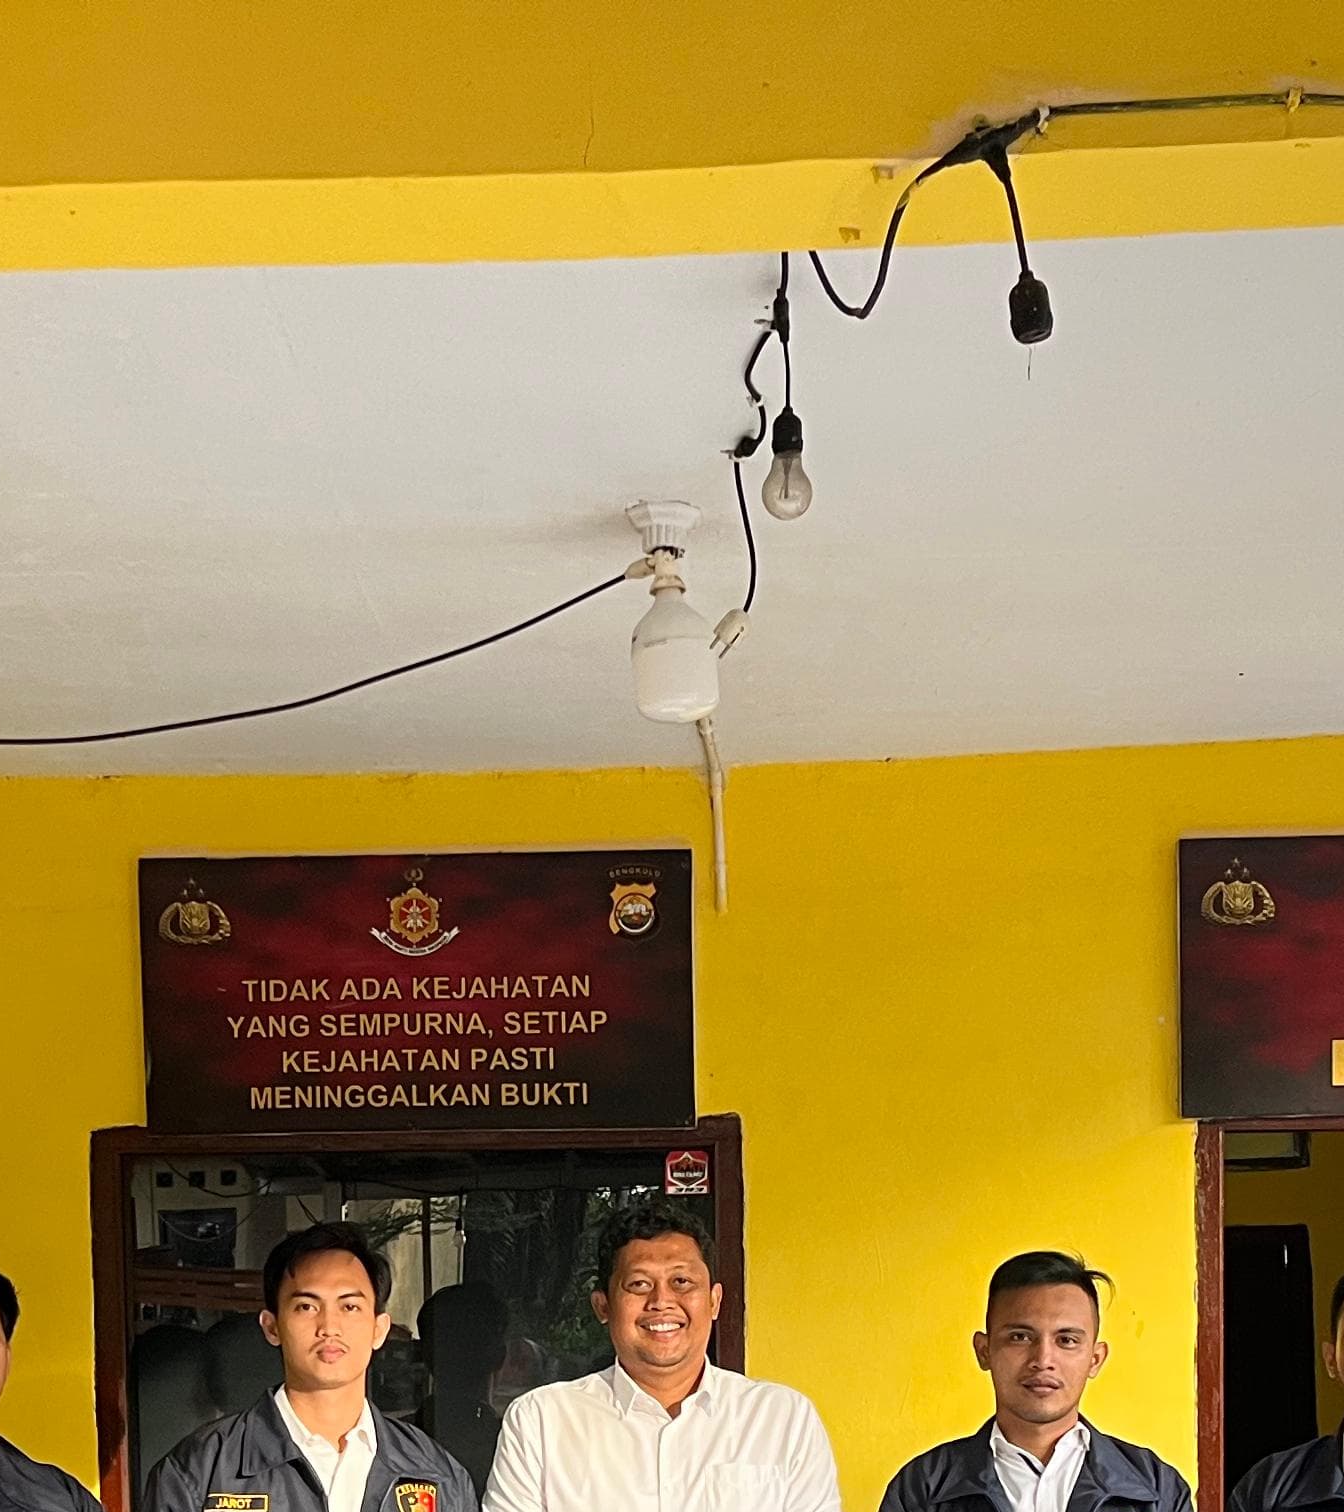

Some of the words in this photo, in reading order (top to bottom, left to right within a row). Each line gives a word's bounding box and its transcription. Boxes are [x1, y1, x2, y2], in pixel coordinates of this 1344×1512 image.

[241, 979, 330, 1002] TIDAK
[340, 977, 402, 1001] ADA
[412, 974, 590, 999] KEJAHATAN
[227, 1014, 310, 1038] YANG
[319, 1012, 495, 1040] SEMPURNA,
[503, 1010, 608, 1035] SETIAP
[282, 1048, 461, 1073] KEJAHATAN
[471, 1047, 554, 1070] PASTI
[250, 1083, 490, 1110] MENINGGALKAN
[501, 1082, 588, 1106] BUKTI
[215, 1497, 252, 1510] JAROT
